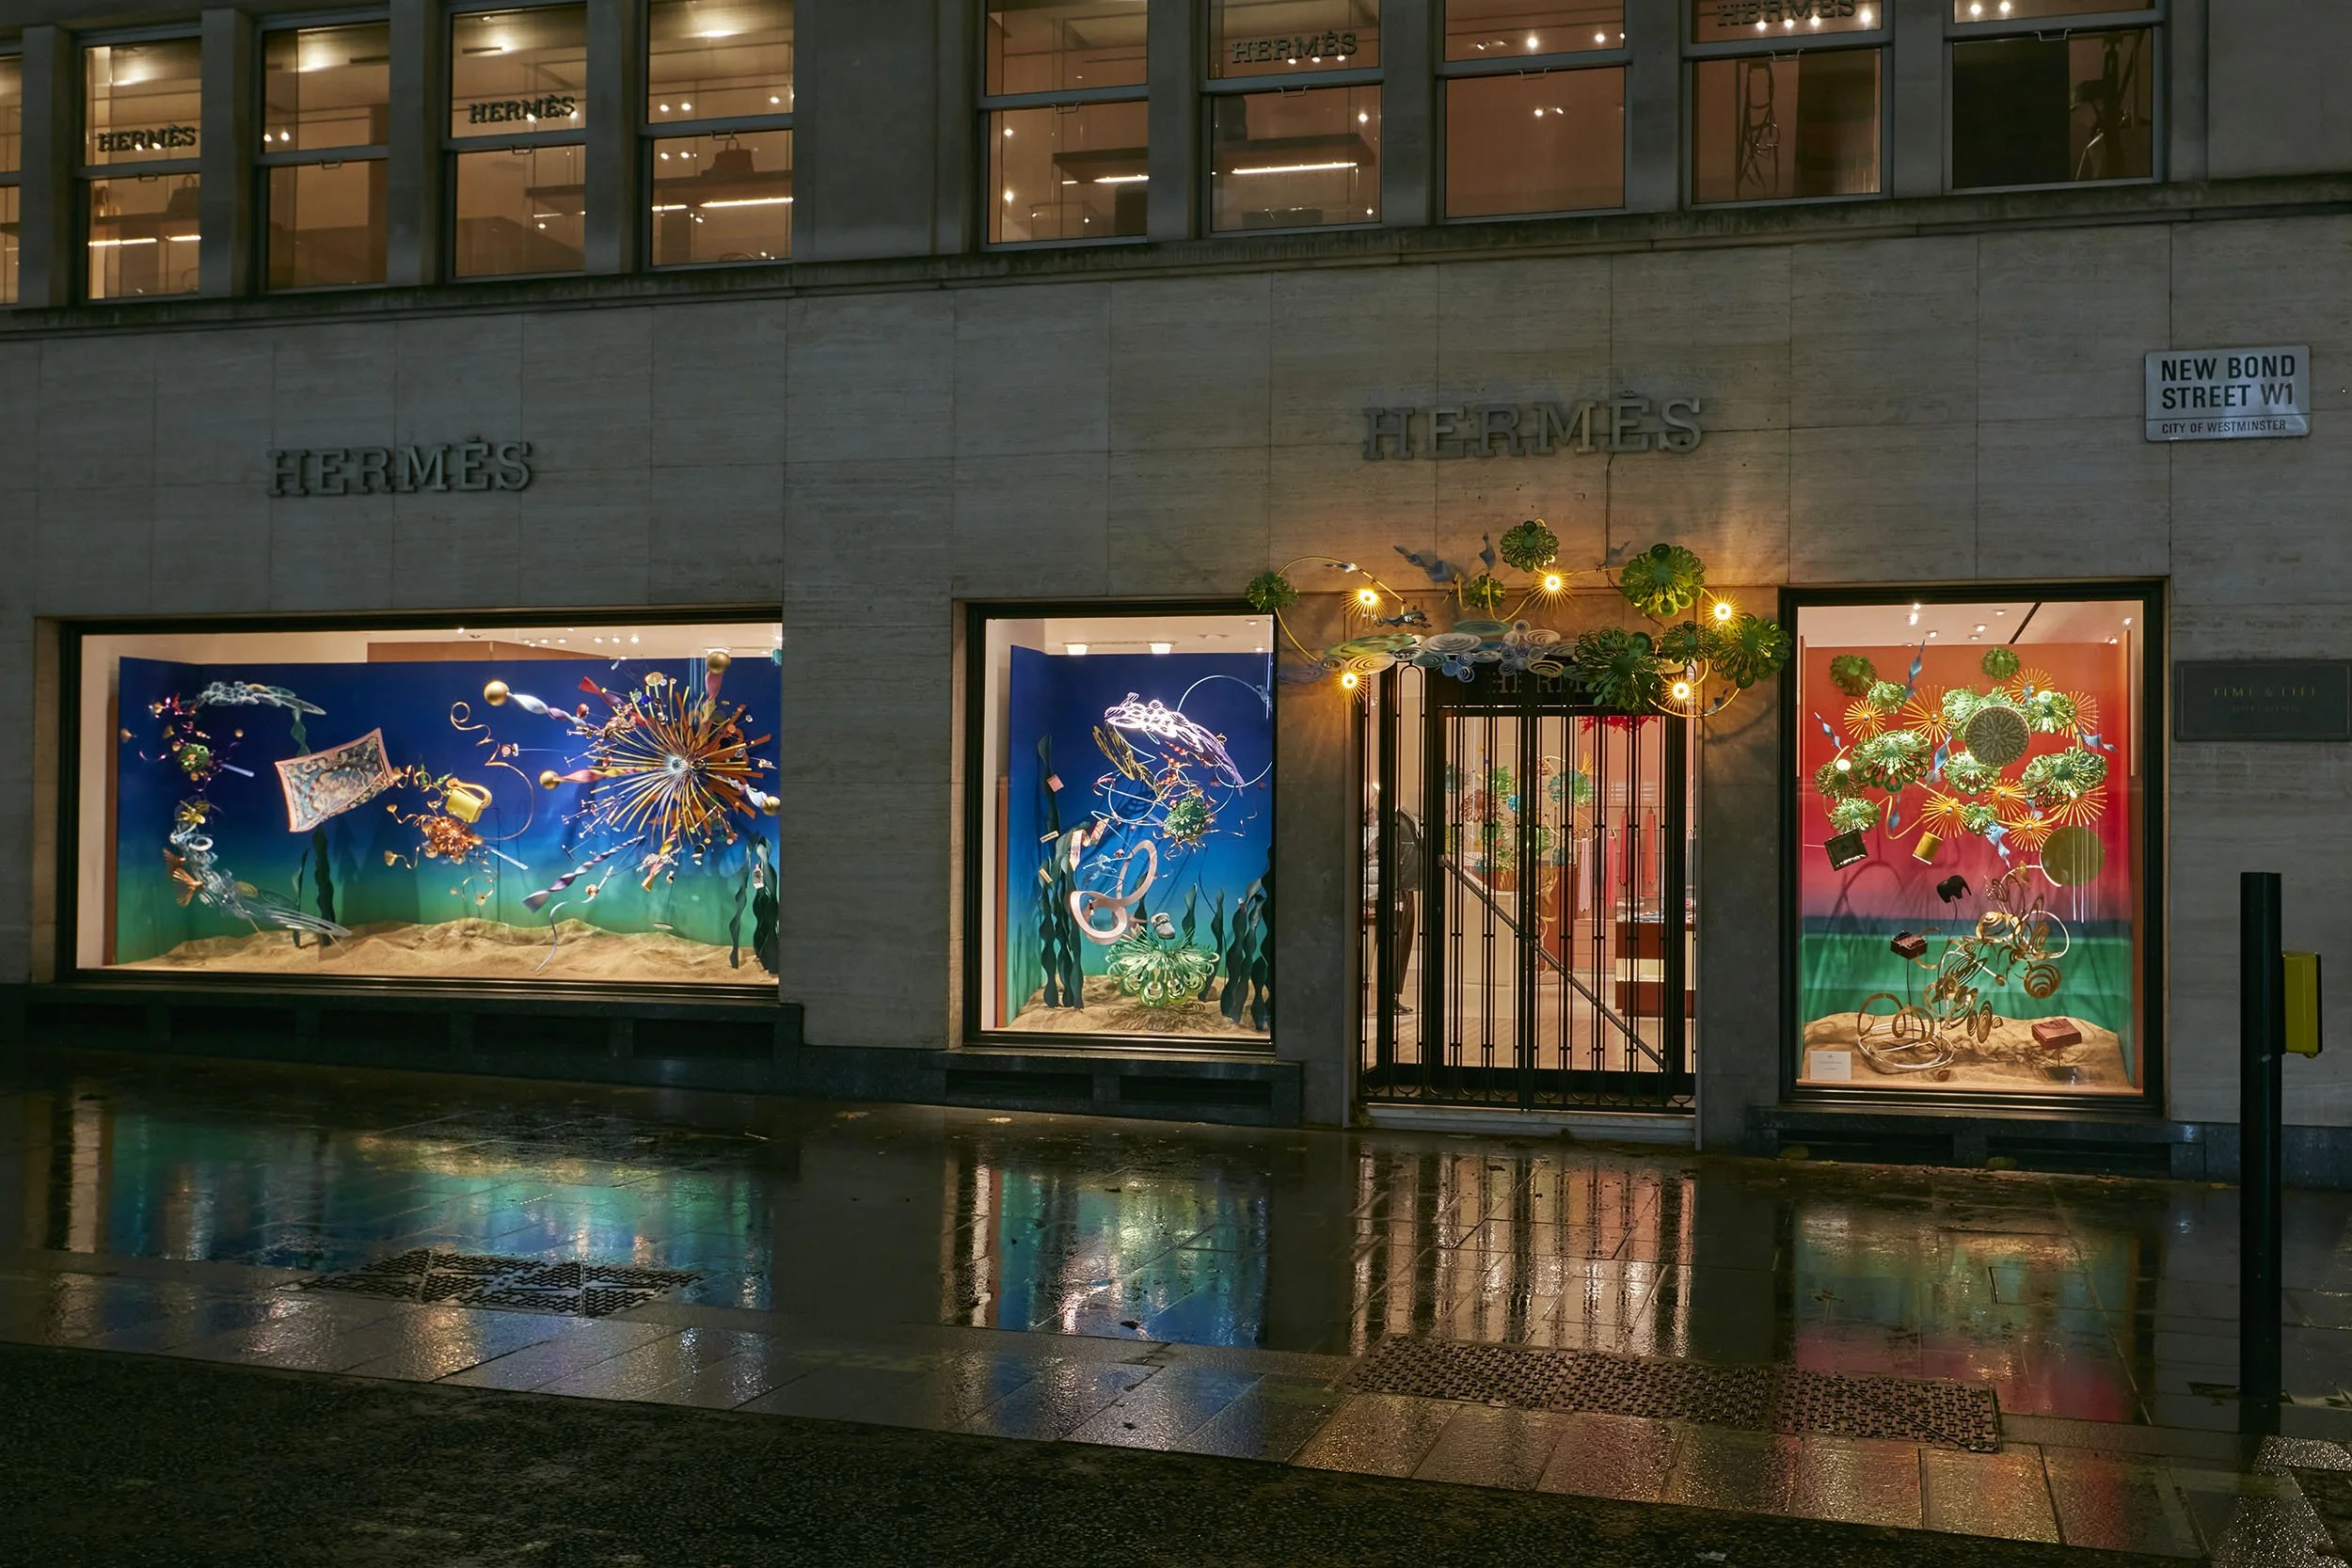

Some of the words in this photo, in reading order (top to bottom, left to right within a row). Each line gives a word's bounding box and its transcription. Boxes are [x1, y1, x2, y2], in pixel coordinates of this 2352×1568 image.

[1232, 29, 1359, 64] HERMÈS
[469, 93, 576, 124] HERMÈS
[97, 124, 197, 152] HERMÈS
[2161, 357, 2217, 382] NEW
[2228, 355, 2296, 379] BOND
[2162, 384, 2251, 410] STREET
[2260, 382, 2294, 405] W1
[1362, 388, 1704, 461] HERMÈS
[2162, 422, 2185, 435] CITY
[2190, 421, 2203, 434] OF
[2206, 420, 2286, 433] WESTMINSTER
[267, 436, 532, 498] HERMÈS
